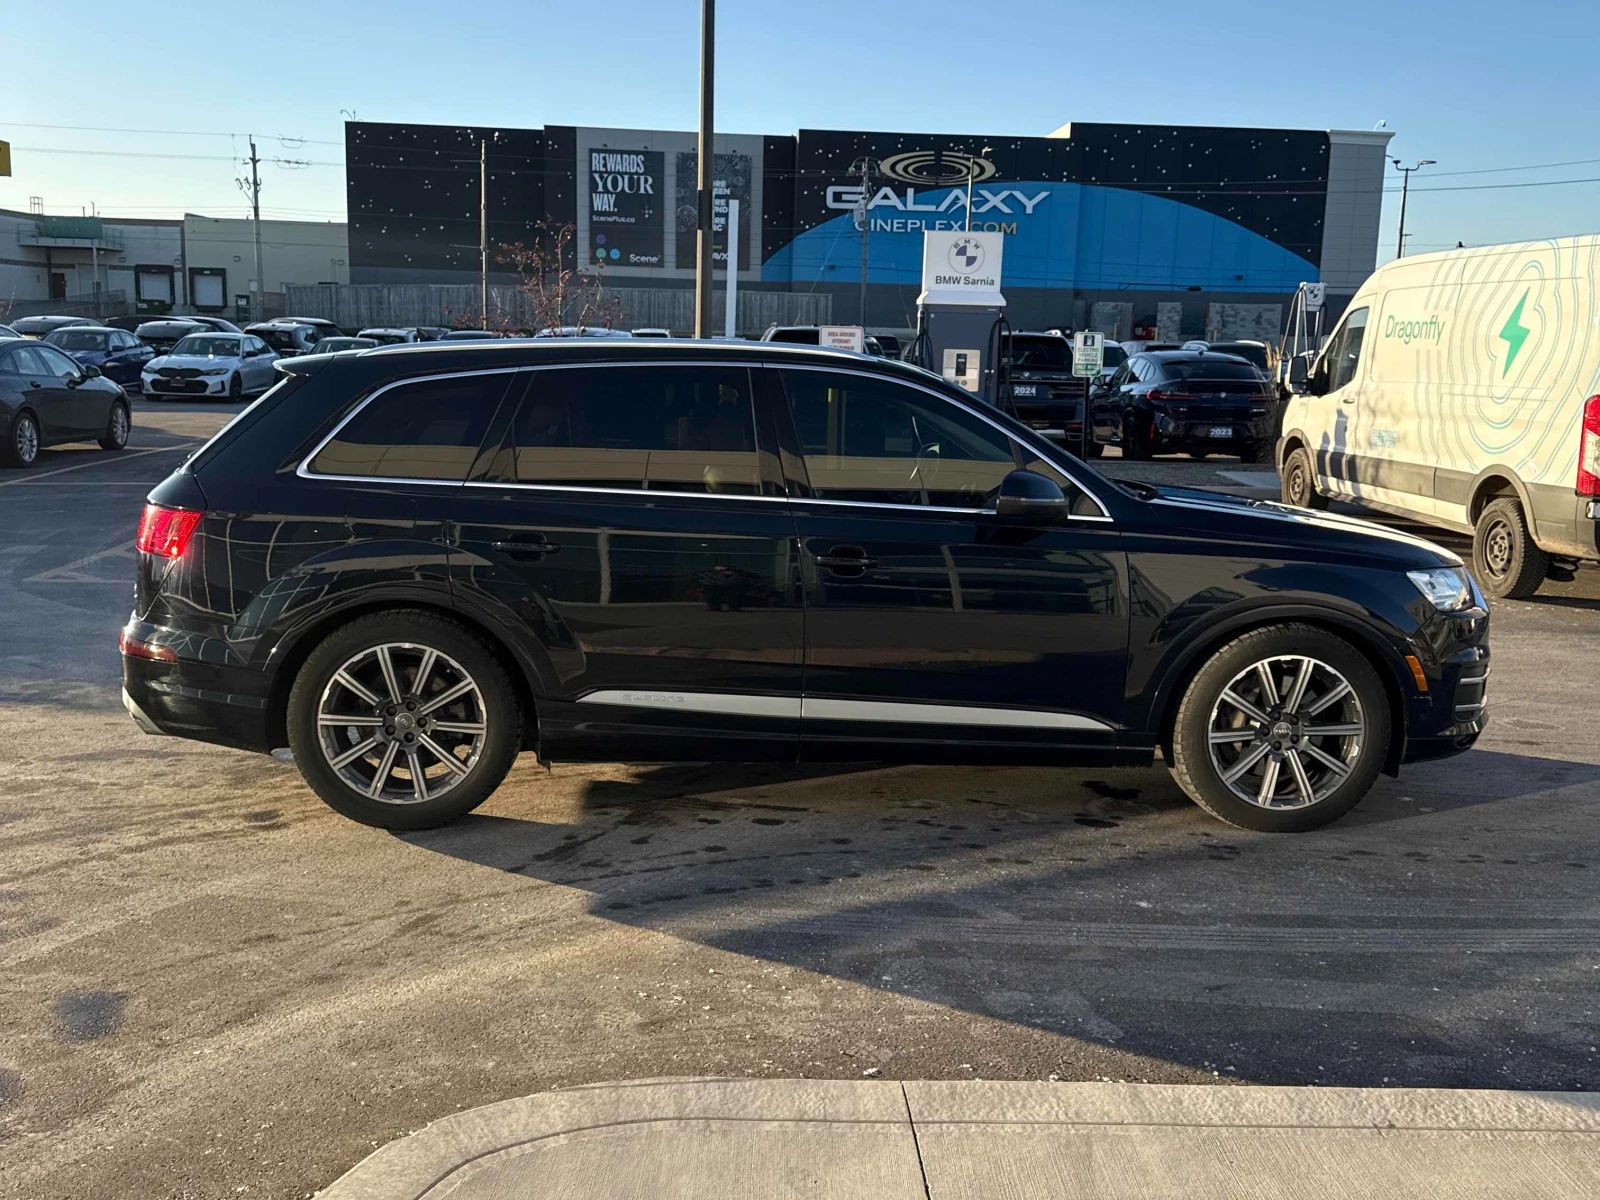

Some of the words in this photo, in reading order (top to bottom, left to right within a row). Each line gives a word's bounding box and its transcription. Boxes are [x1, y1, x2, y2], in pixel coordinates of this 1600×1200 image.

[592, 153, 644, 173] REWARDS
[593, 173, 654, 194] YOUR
[592, 193, 617, 212] WAY.
[826, 186, 1051, 214] GALAXY
[592, 215, 635, 223] ScenePlus.ca
[953, 239, 981, 249] BMW
[935, 276, 961, 285] BMW
[963, 276, 995, 286] Sarnia
[1385, 315, 1446, 346] Dragonfly
[1014, 386, 1036, 394] 2024
[1210, 428, 1232, 436] 2023
